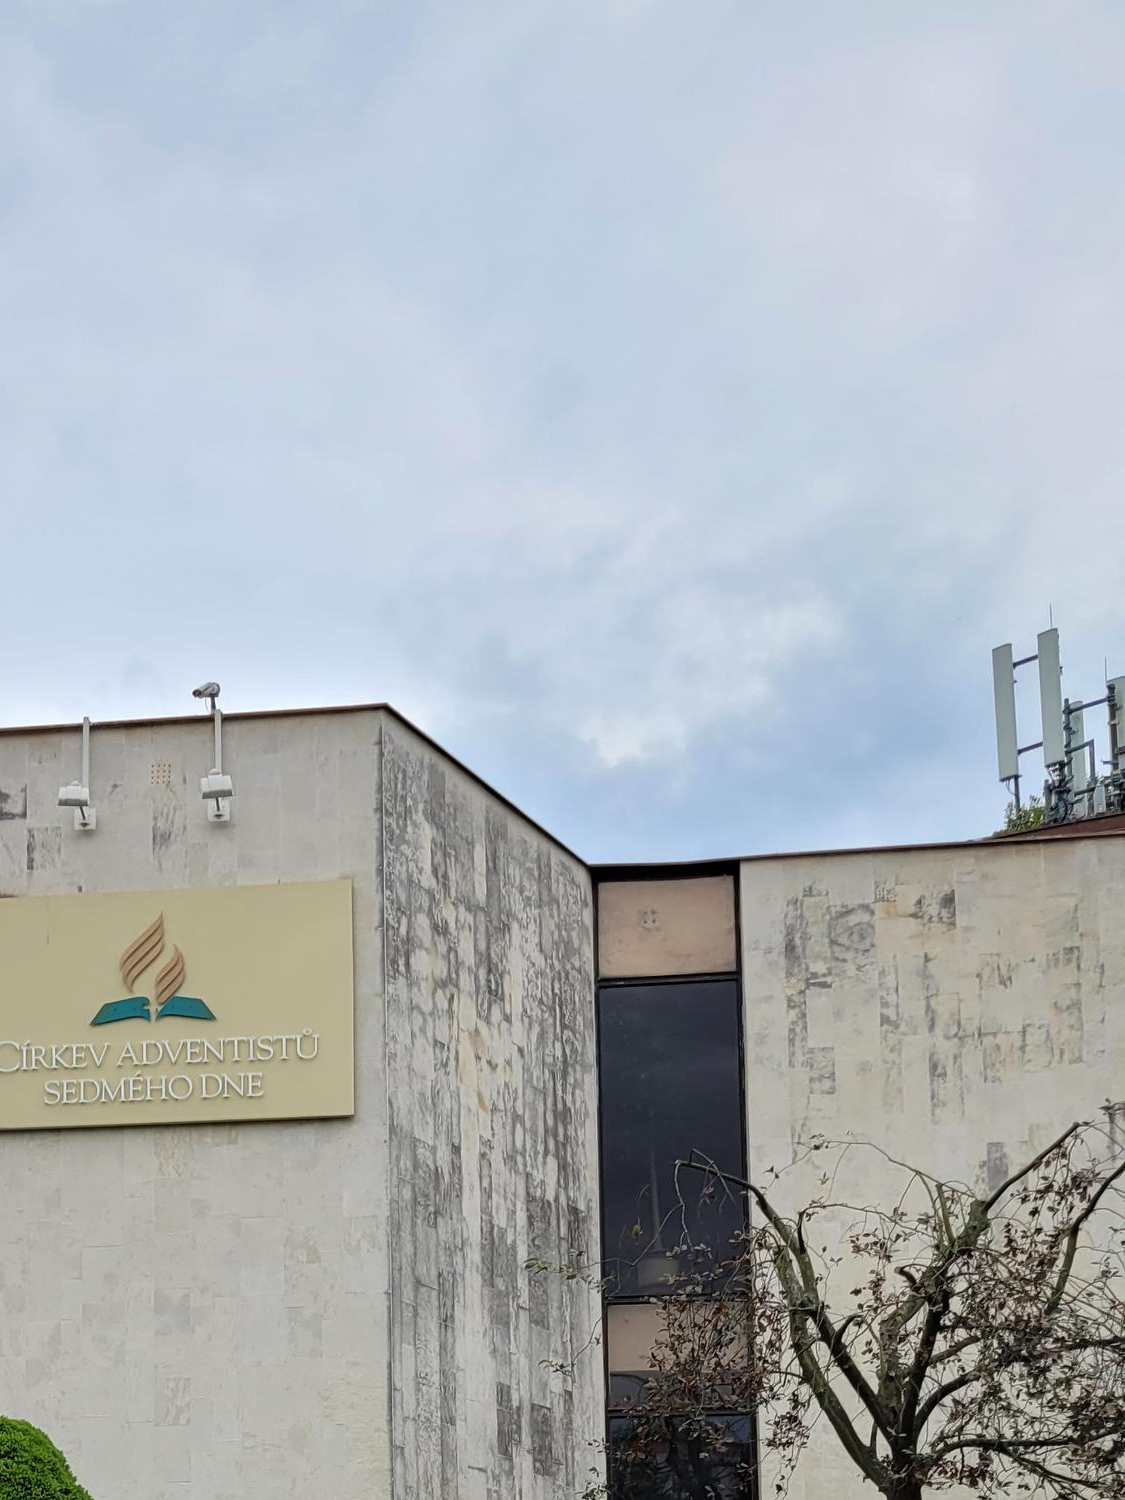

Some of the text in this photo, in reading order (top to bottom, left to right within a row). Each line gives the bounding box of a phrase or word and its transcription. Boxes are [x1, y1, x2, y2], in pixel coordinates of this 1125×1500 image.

[116, 1027, 320, 1068] ADVENTISTŮ
[43, 1071, 265, 1105] SEDMÉHO DNE
